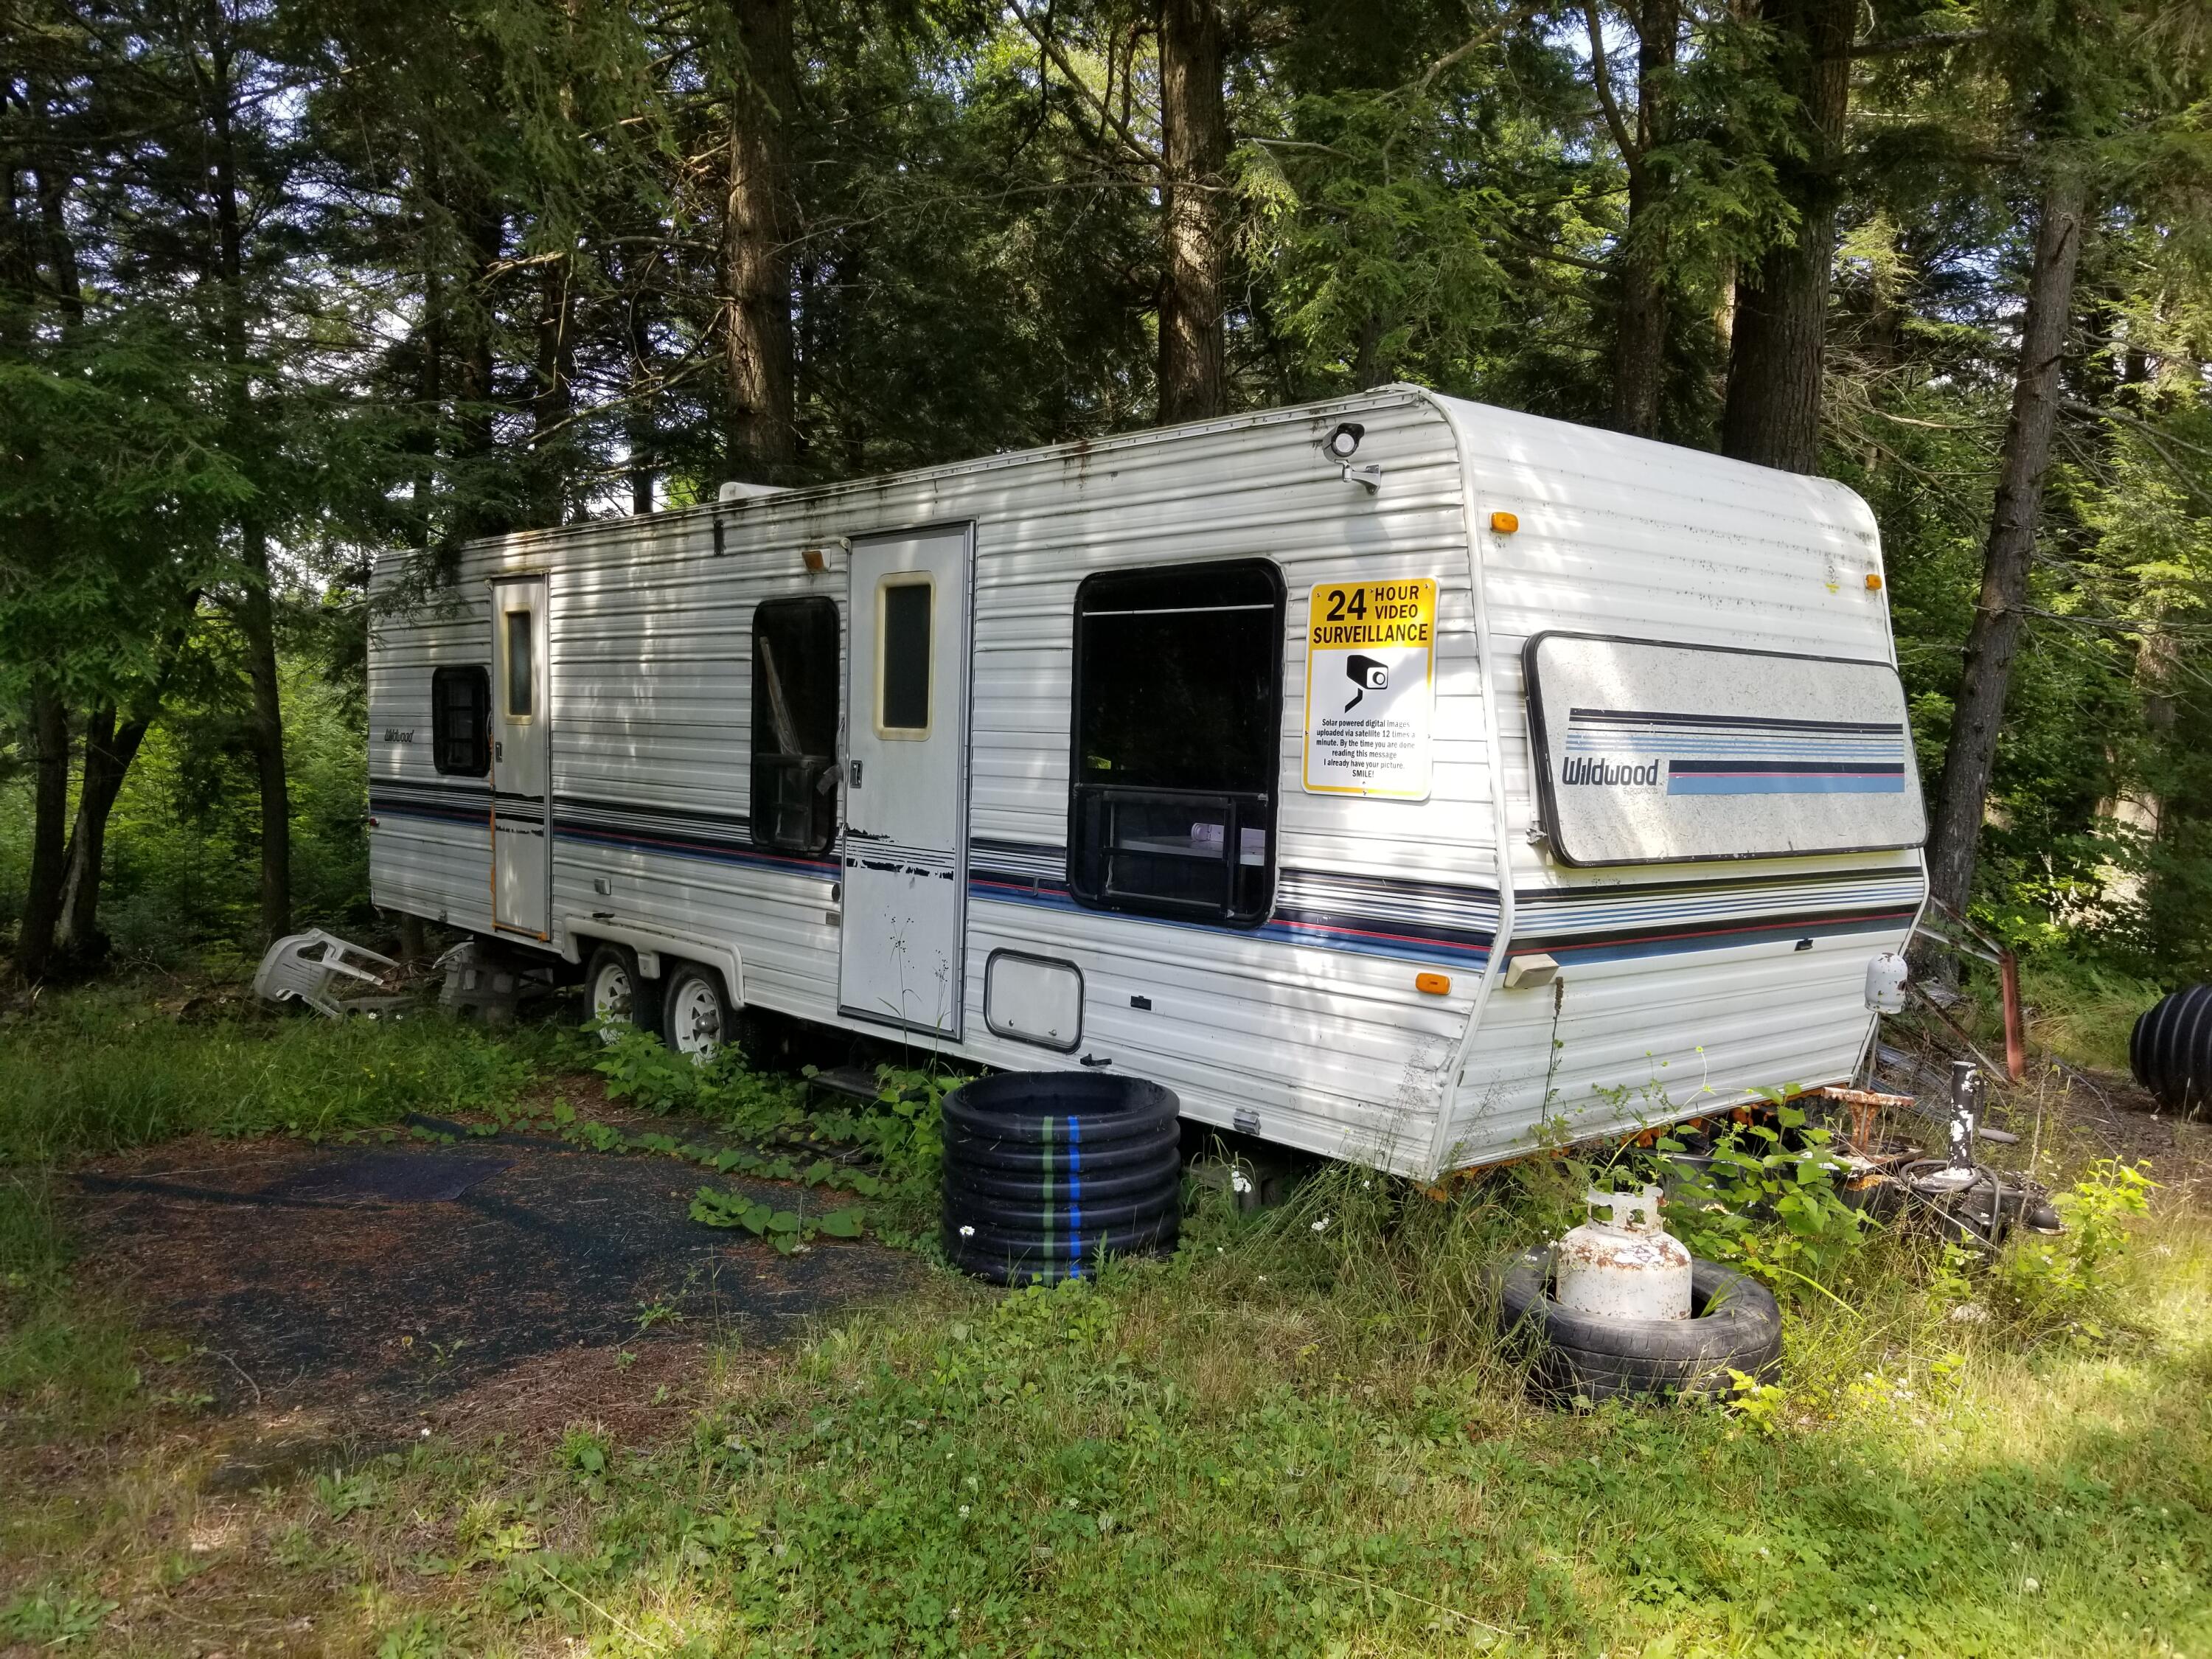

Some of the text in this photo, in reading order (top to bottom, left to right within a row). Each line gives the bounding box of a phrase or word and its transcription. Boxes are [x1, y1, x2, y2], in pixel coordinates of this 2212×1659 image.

[1326, 585, 1419, 622] 24 HOUR
[1375, 604, 1418, 619] VIDEO
[1312, 623, 1428, 644] SURVEILLANCE
[1322, 718, 1410, 728] Solar powered digital images
[1340, 739, 1348, 748] By
[1332, 749, 1355, 758] reading
[1368, 751, 1397, 759] message
[1327, 759, 1349, 768] already
[1350, 759, 1365, 768] have
[1352, 770, 1374, 778] SMILE!
[1562, 757, 1659, 785] Wildwood
